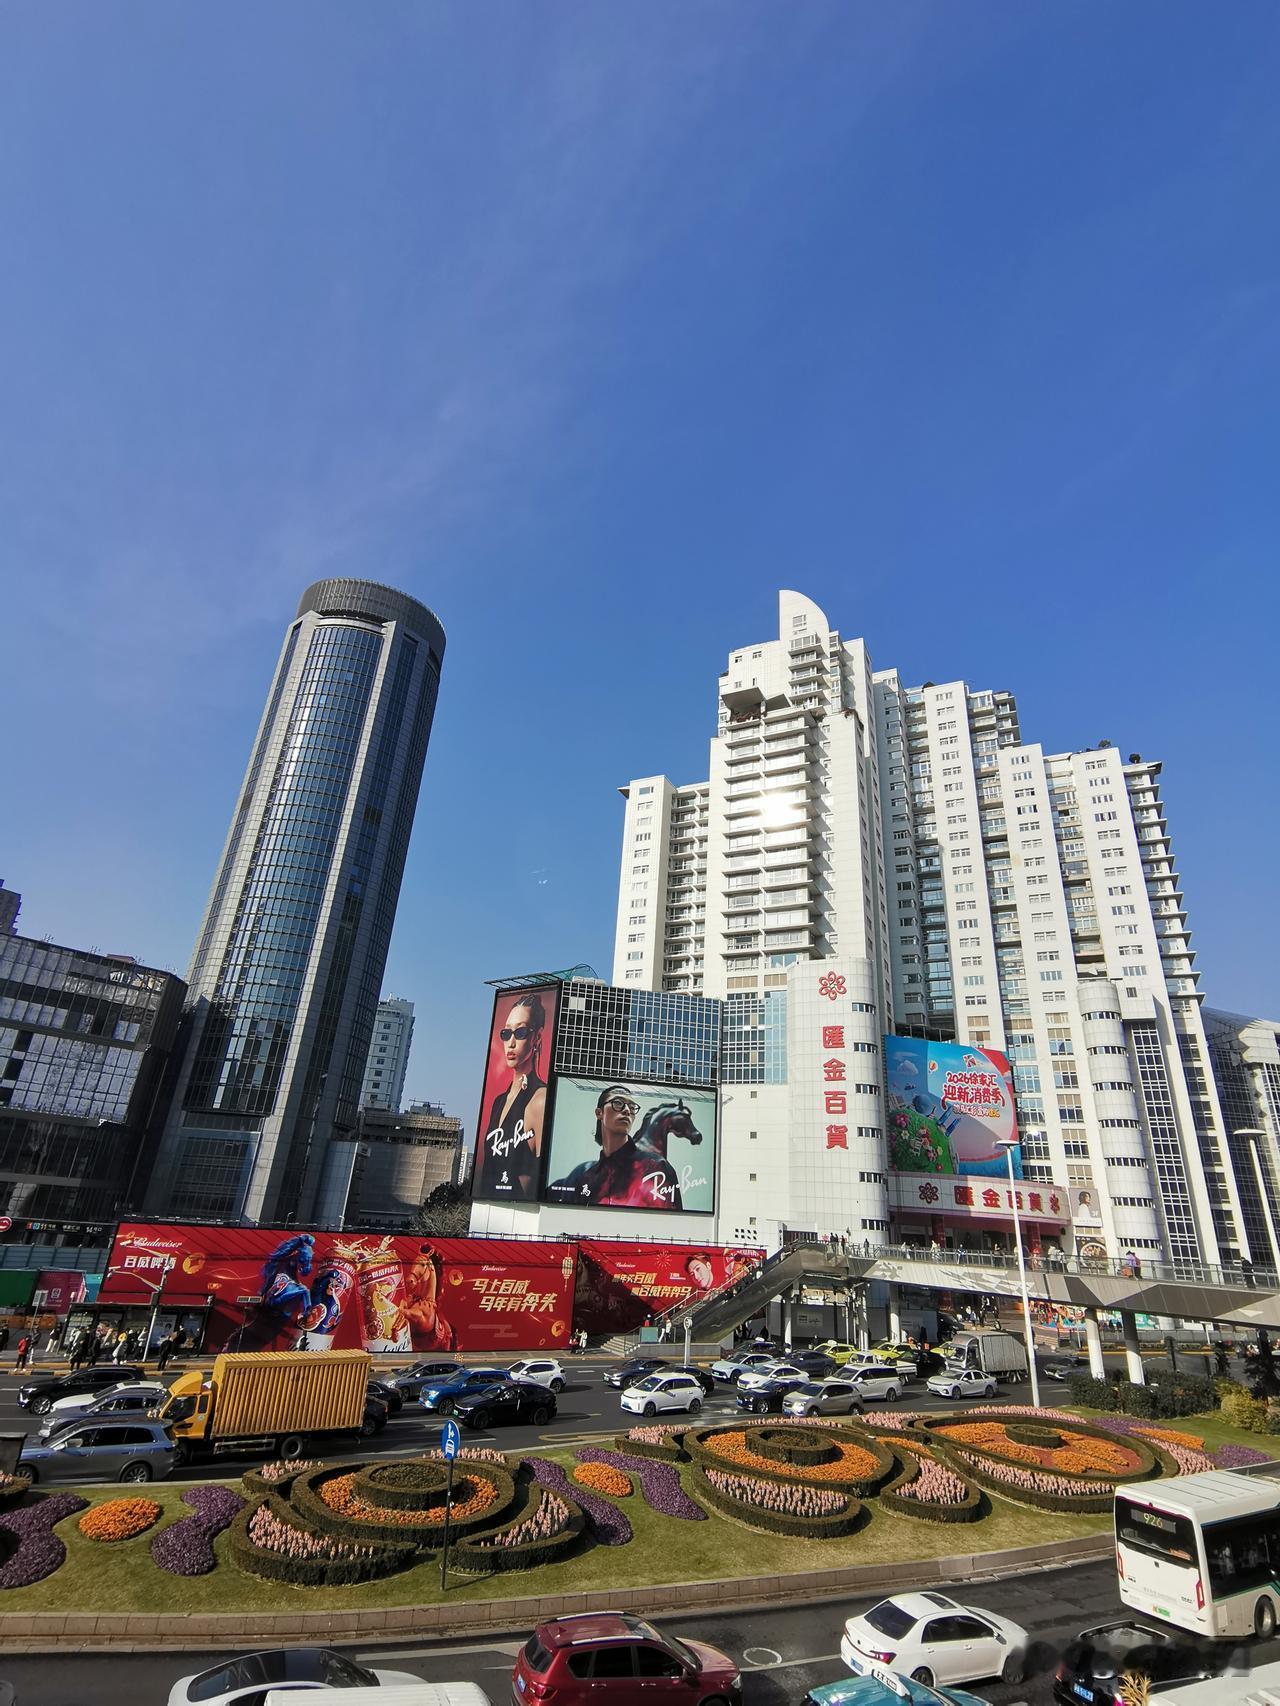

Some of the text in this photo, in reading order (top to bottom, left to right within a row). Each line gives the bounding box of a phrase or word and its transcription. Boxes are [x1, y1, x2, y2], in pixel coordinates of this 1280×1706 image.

[822, 1025, 849, 1150] 匯金百貨
[945, 1071, 998, 1087] 2026徐家汇
[941, 1084, 1005, 1110] 迎新消费季
[953, 1185, 1044, 1214] 匯金百貨
[134, 1237, 182, 1249] Budweiser
[472, 1278, 531, 1295] 马上百威
[479, 1292, 558, 1312] 马年有奔头
[1143, 1512, 1163, 1529] 926
